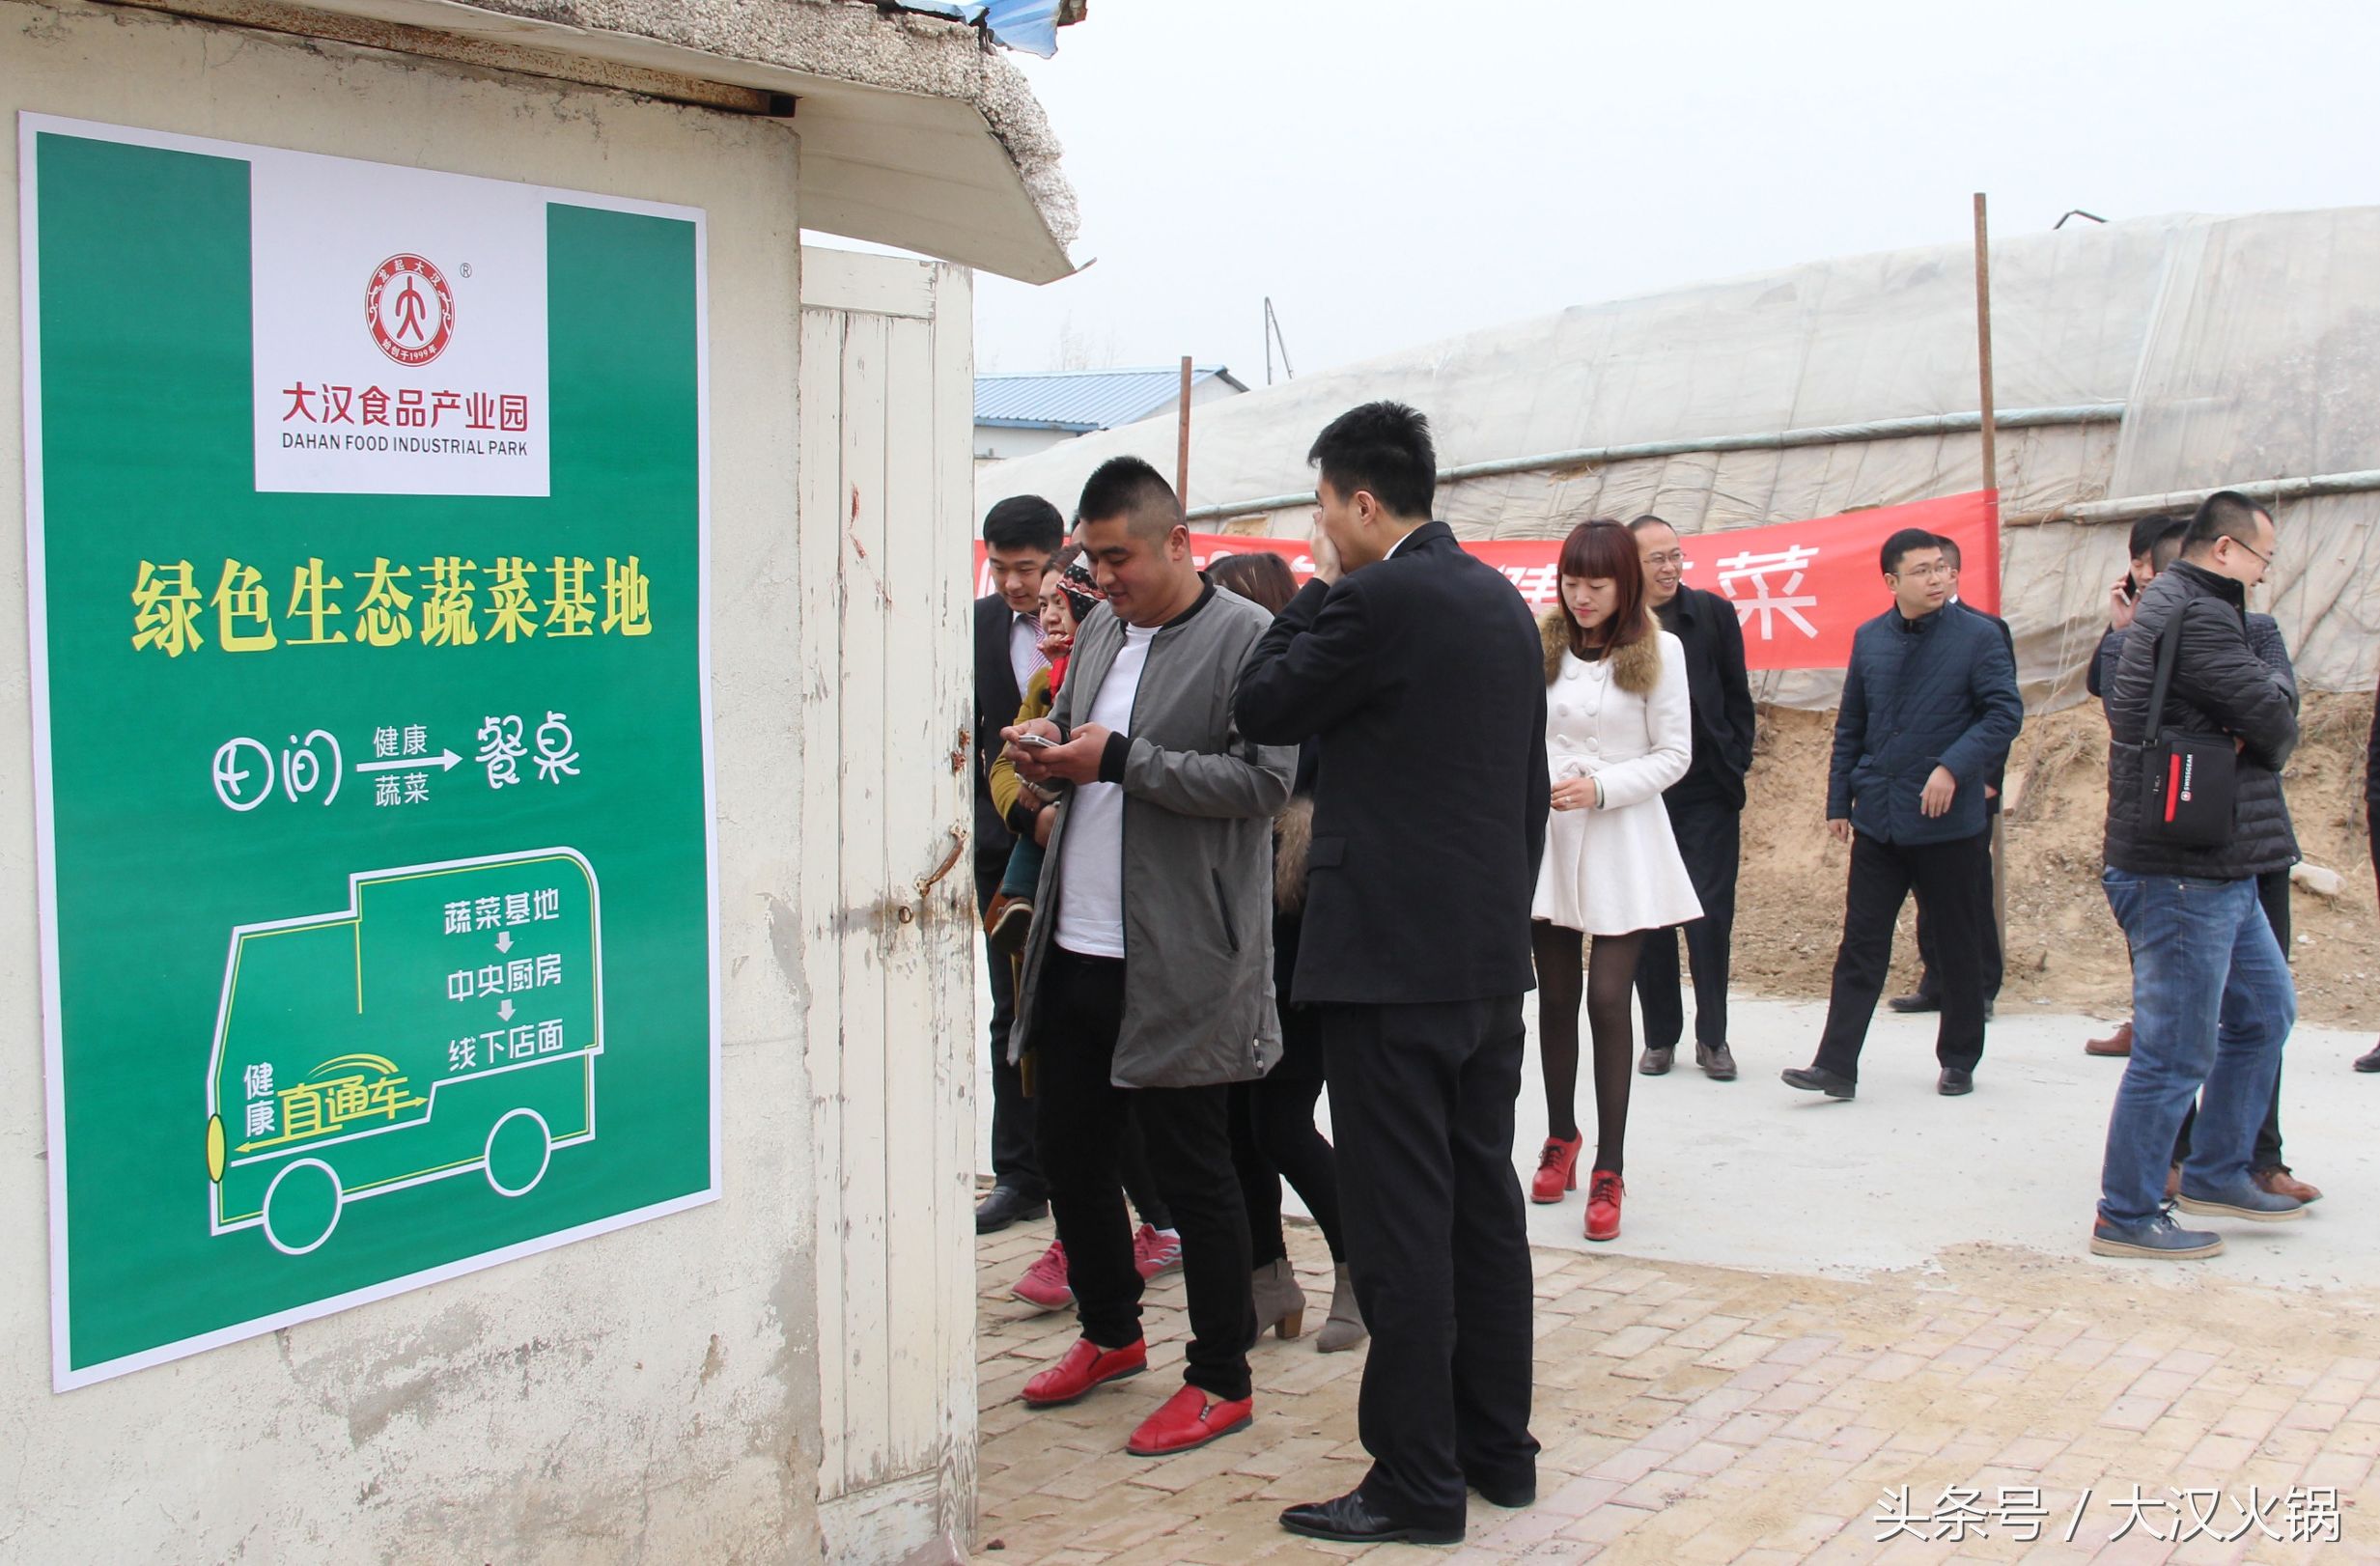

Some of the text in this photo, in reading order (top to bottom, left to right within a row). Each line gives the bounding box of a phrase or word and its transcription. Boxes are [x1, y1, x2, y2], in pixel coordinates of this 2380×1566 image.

[381, 338, 437, 361] 始创于1999年
[283, 381, 528, 432] 大汉食品产业园
[282, 433, 528, 456] DAHAN FOOD INDUSTRIAL PARK
[130, 555, 654, 658] 绿色生态蔬菜基地
[373, 723, 429, 759] 健康
[475, 710, 581, 790] 餐桌
[212, 728, 343, 812] 田间
[374, 771, 430, 808] 蔬菜
[2183, 753, 2194, 791] SWISSGEAR
[443, 887, 561, 936] 蔬菜基地
[447, 952, 562, 1002] 中央厨房
[447, 1018, 564, 1073] 线下店面
[243, 1061, 277, 1138] 健康
[276, 1073, 411, 1140] 直通车
